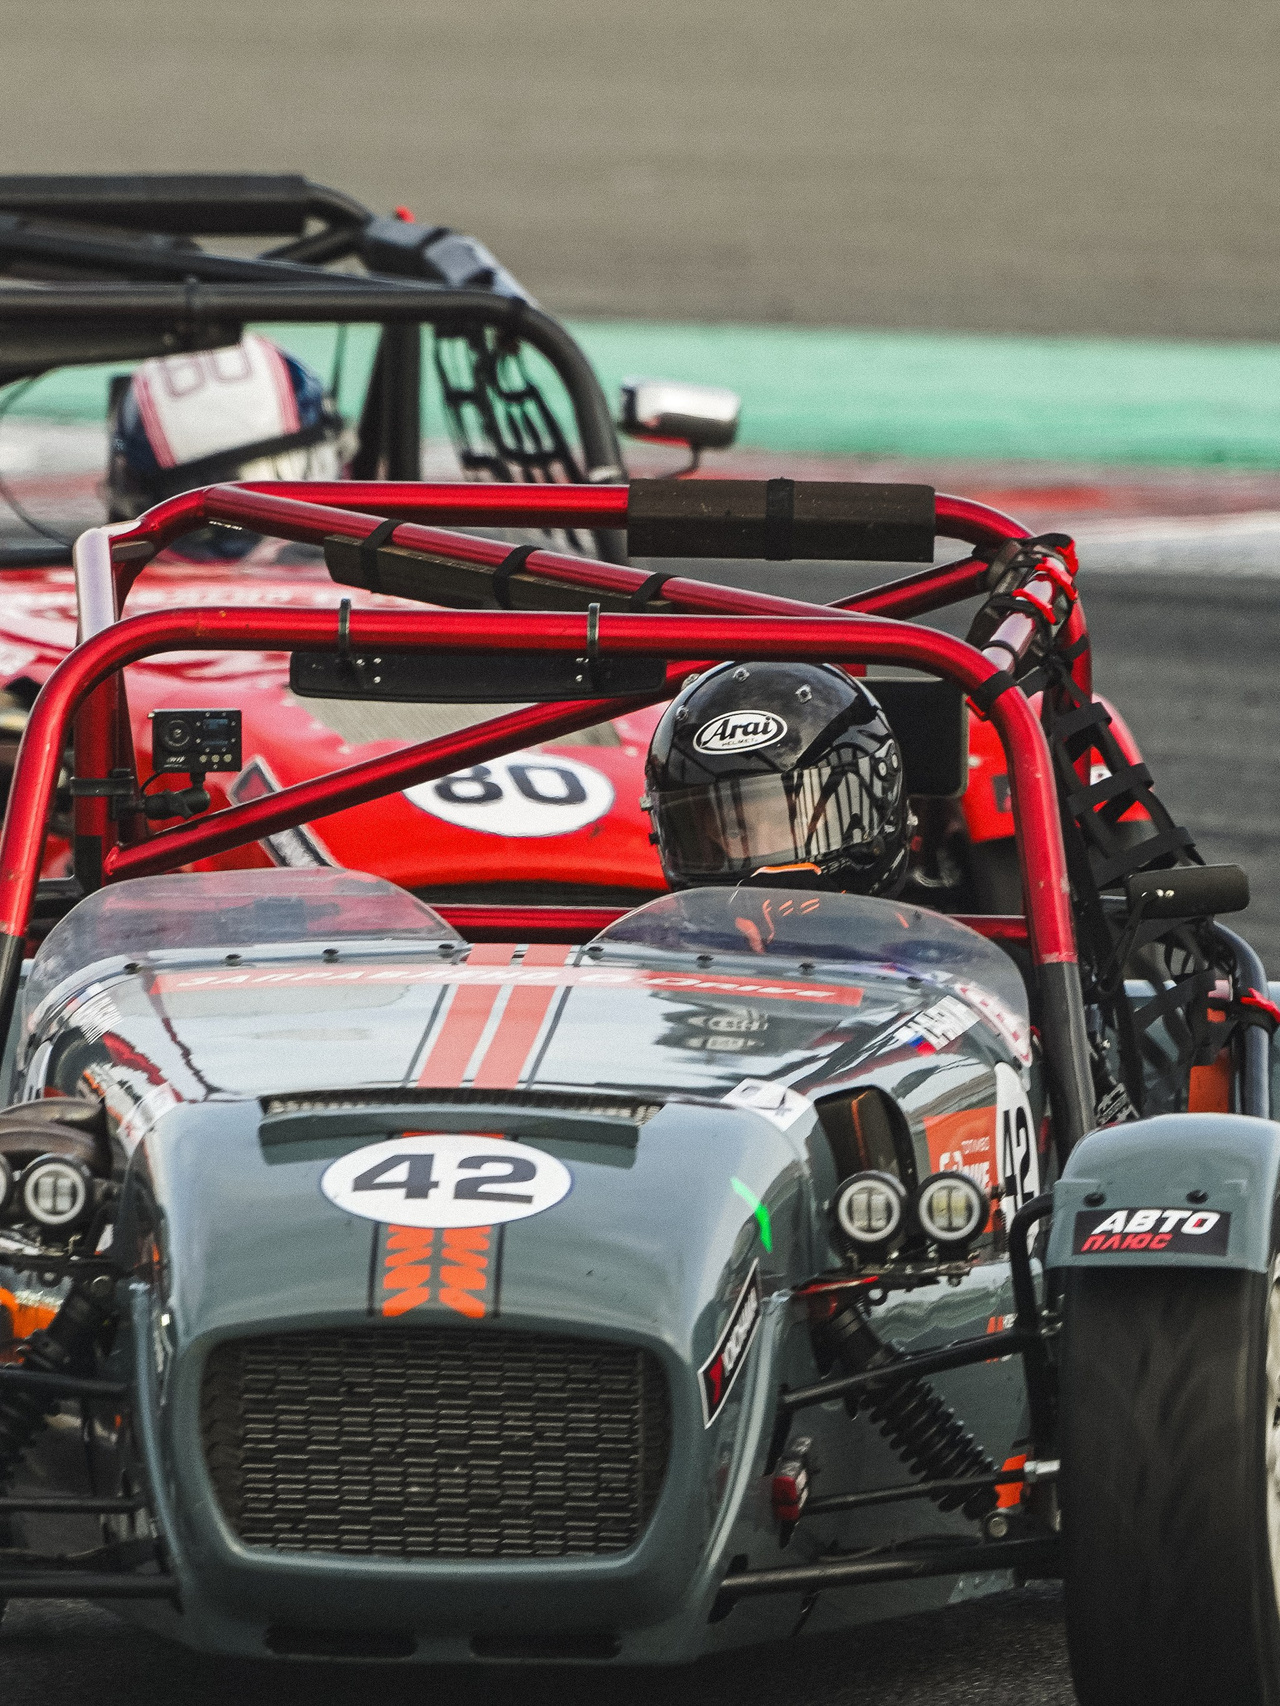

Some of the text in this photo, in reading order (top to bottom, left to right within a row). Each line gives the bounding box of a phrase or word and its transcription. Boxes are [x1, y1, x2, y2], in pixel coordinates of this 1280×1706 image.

[700, 716, 772, 747] Arai
[434, 754, 587, 806] 80
[176, 970, 561, 988] ЗАПРАВЛЕНО
[1003, 1106, 1035, 1213] 42
[352, 1154, 537, 1204] 42
[1091, 1209, 1221, 1235] АВТО
[1080, 1233, 1173, 1252] ПЛЮС
